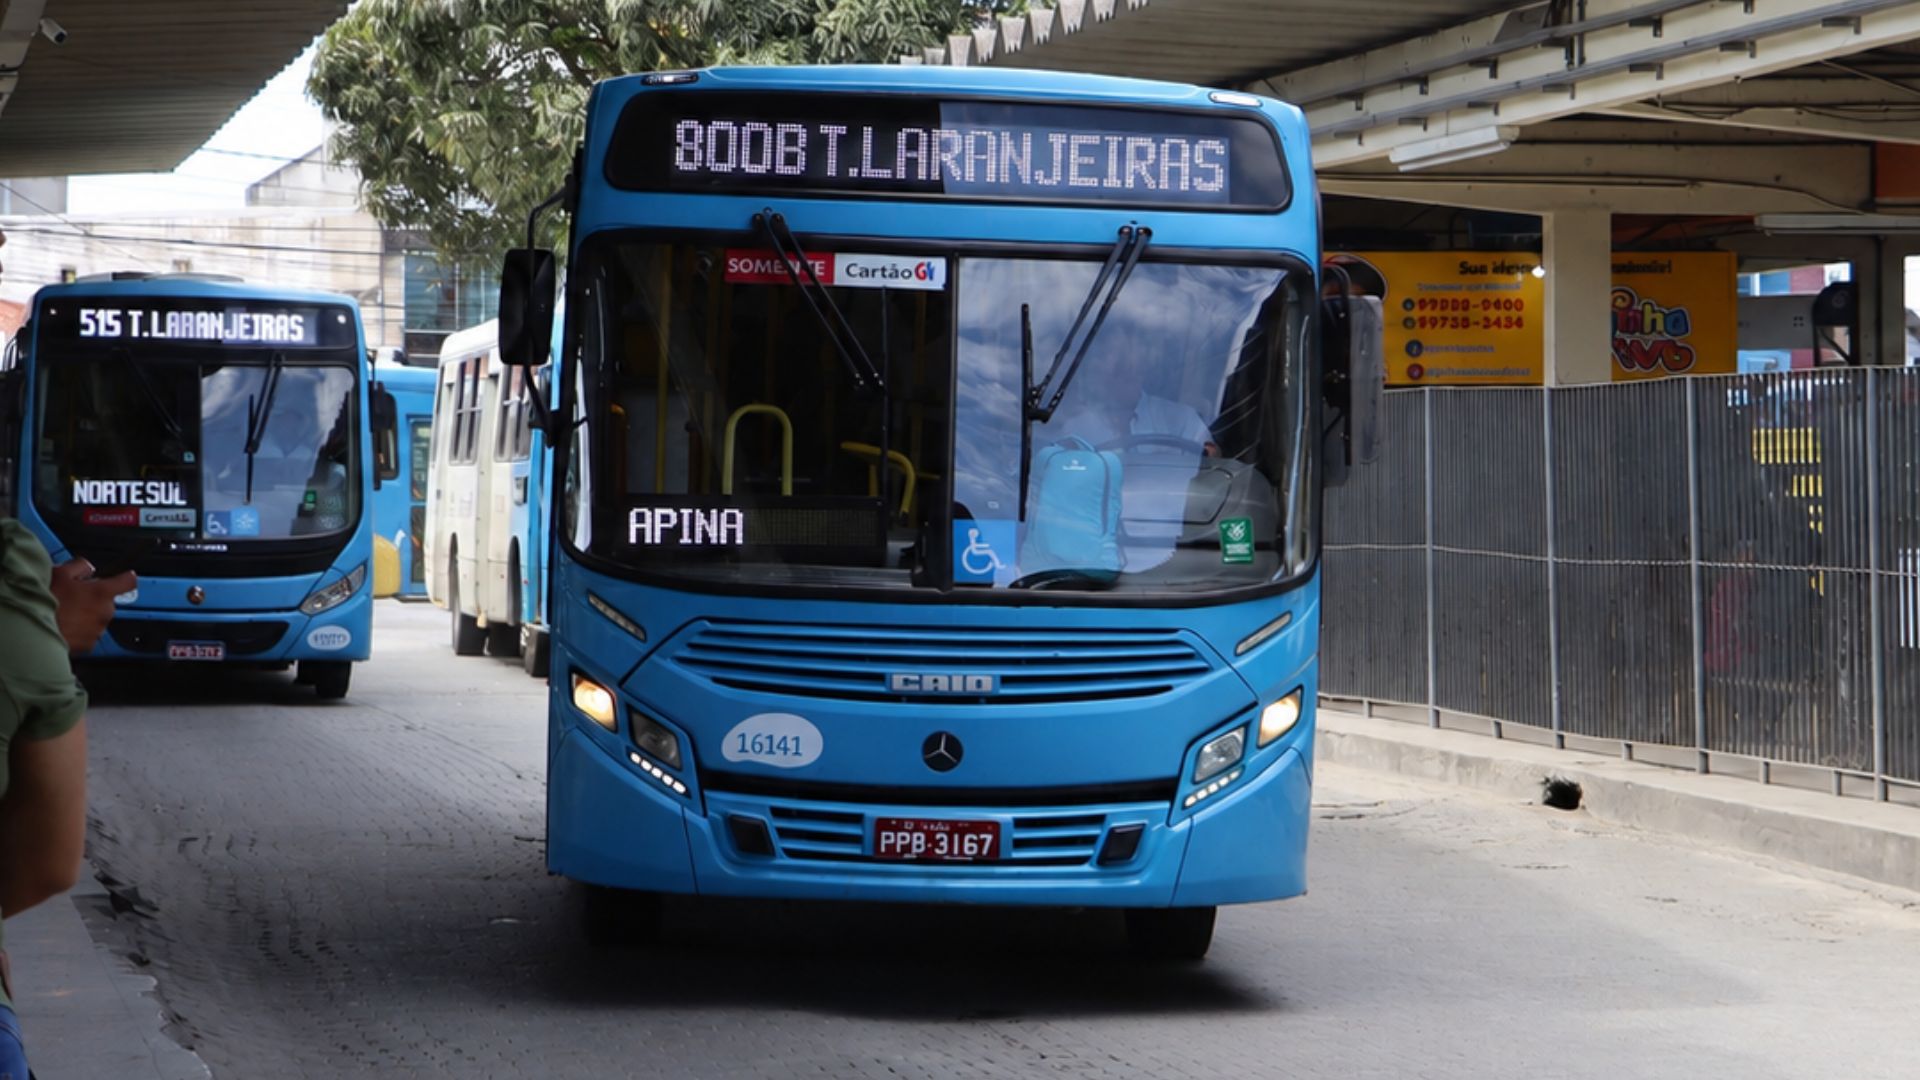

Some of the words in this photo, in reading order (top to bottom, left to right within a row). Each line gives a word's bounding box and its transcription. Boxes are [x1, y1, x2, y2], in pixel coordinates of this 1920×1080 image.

[819, 125, 1225, 192] T.LARANJEIRAS
[80, 309, 122, 337] 515
[128, 311, 305, 342] T.LARANJEIRAS
[628, 508, 744, 544] APINA
[892, 673, 993, 692] CAIO
[736, 732, 803, 757] 16141
